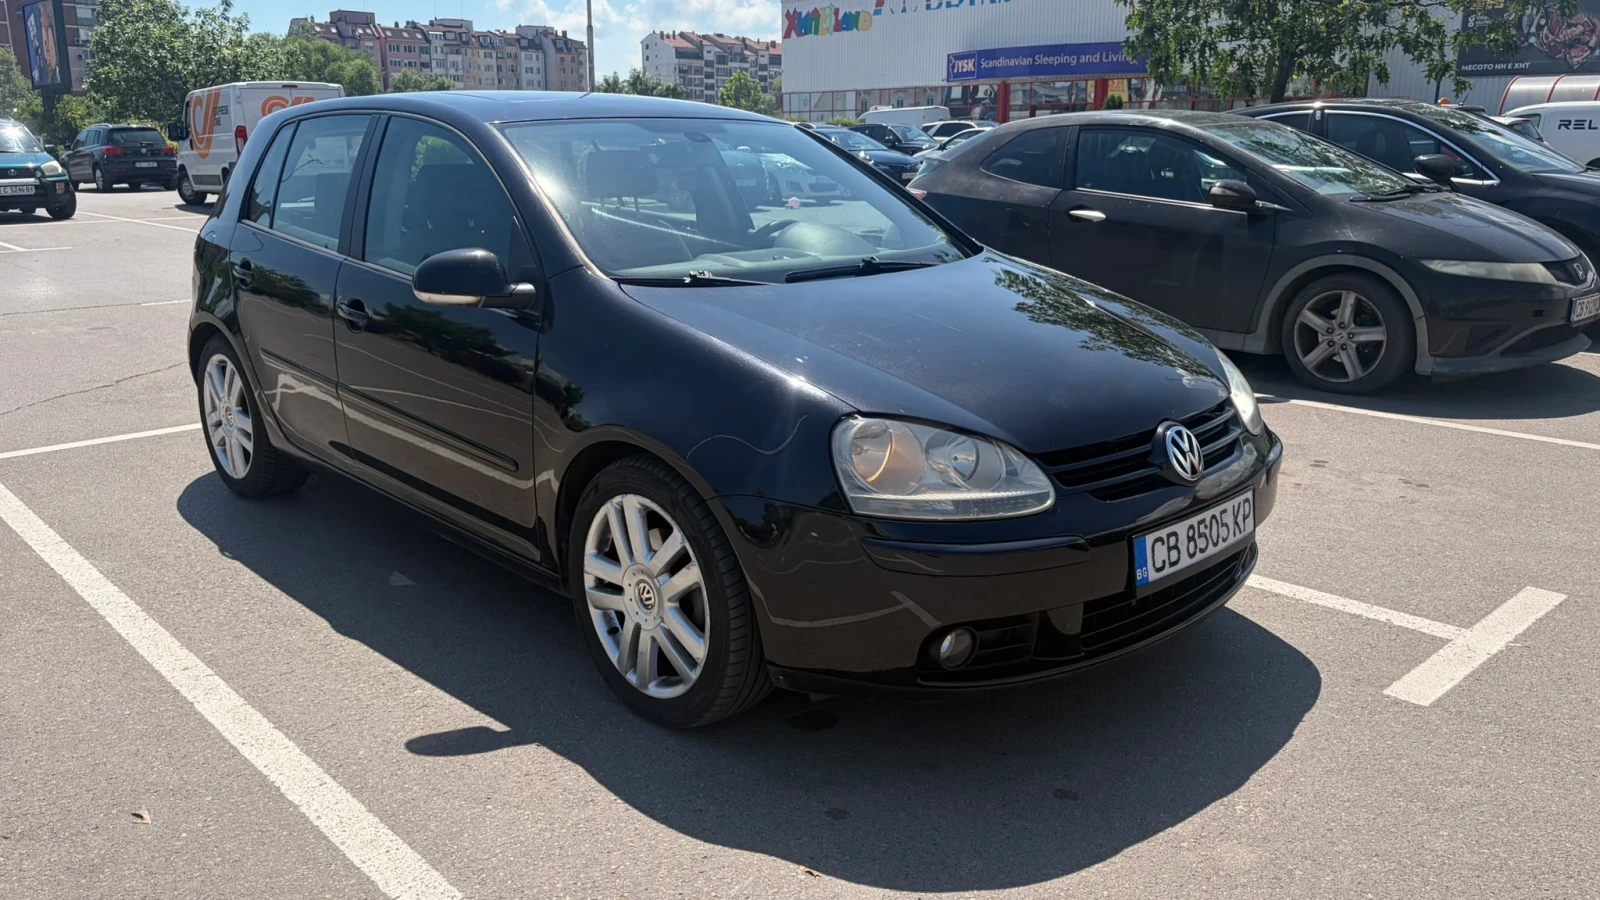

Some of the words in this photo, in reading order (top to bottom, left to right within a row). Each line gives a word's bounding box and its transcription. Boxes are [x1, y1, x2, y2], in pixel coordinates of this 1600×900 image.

[953, 58, 975, 73] JYSK
[981, 55, 1033, 69] Scandinavian
[1034, 53, 1077, 66] Sleeping
[1079, 51, 1100, 62] and
[1461, 63, 1494, 71] МЕСОТО
[1557, 119, 1600, 130] REL
[1151, 531, 1181, 573] CB
[1186, 508, 1230, 559] 8505
[1232, 497, 1251, 536] KP
[1136, 567, 1148, 580] BG
